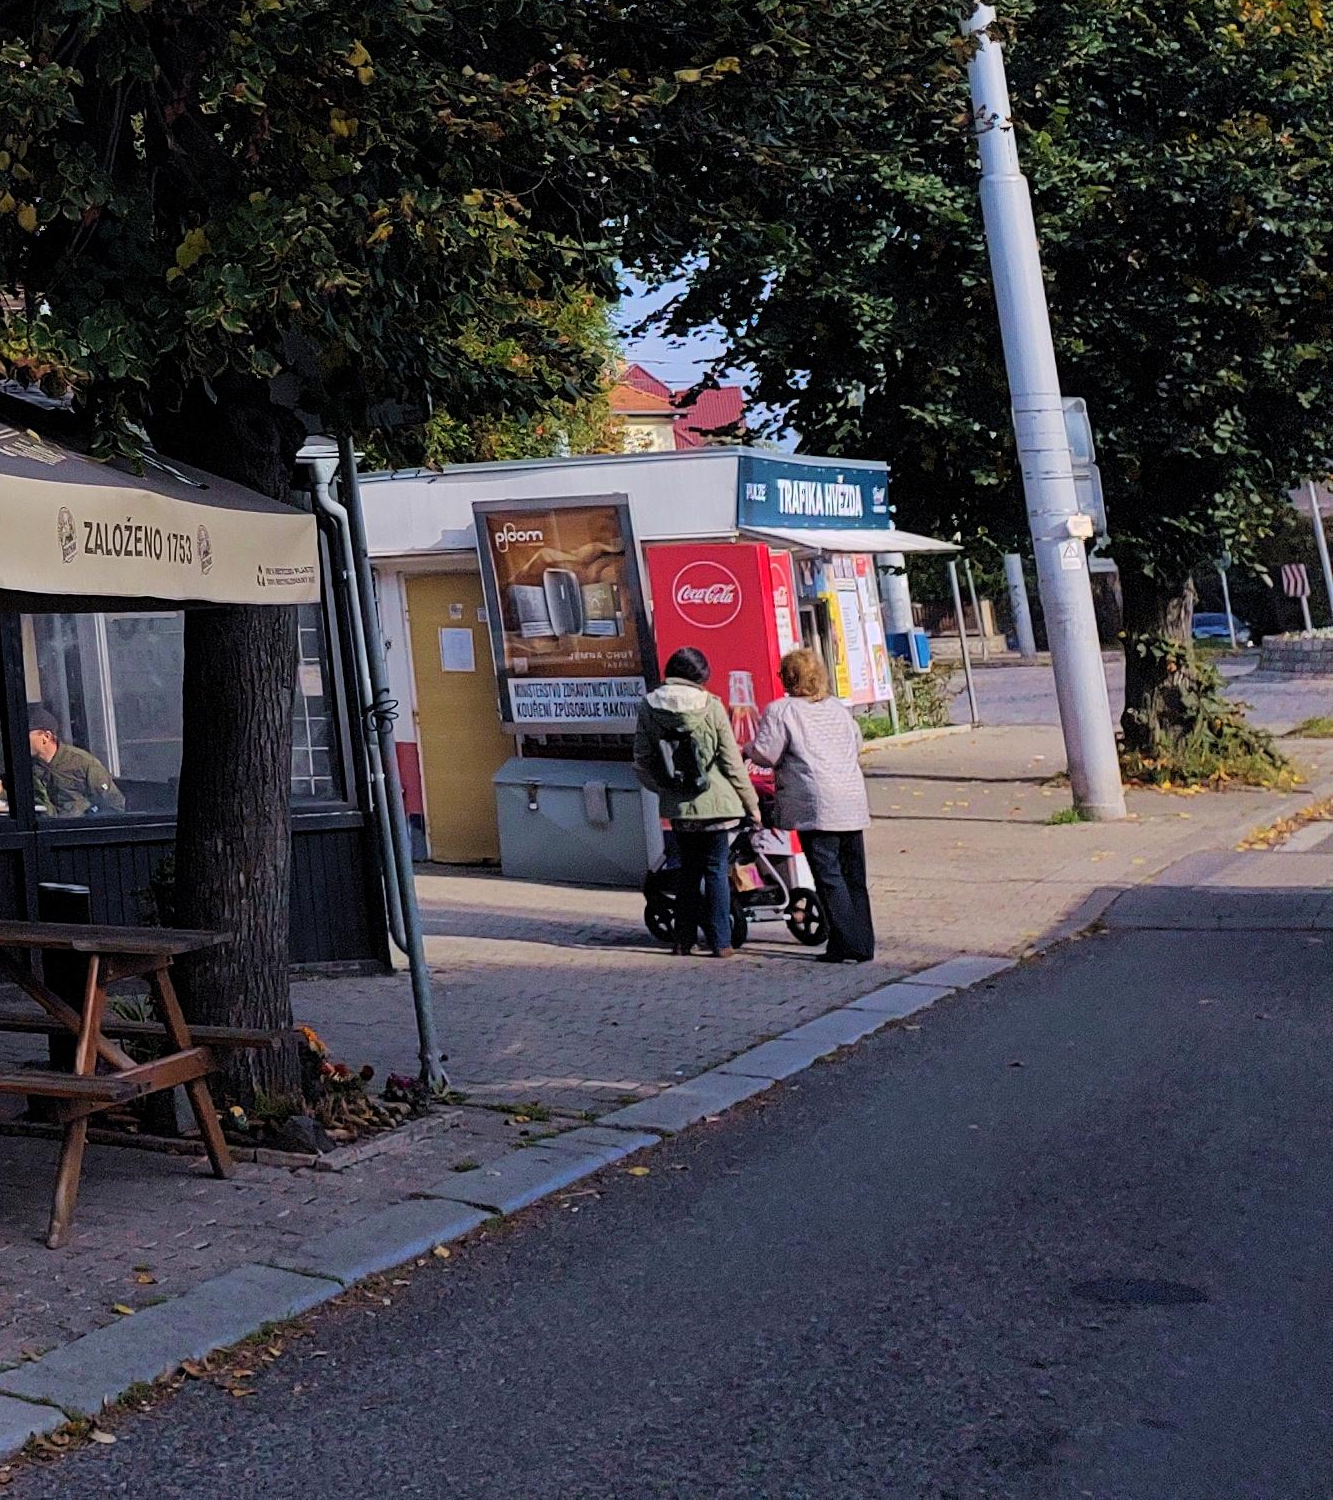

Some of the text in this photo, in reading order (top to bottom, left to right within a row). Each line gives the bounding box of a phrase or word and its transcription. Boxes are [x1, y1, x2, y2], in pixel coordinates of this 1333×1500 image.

[776, 478, 824, 516] TRAFIKA
[83, 516, 163, 560] ZALOŽENO
[167, 532, 193, 565] 1753
[495, 522, 544, 553] ploom
[677, 583, 736, 604] Coca-Cola
[517, 700, 552, 718] KOUŘENÍ
[554, 700, 602, 718] ZPŮSOBUJE
